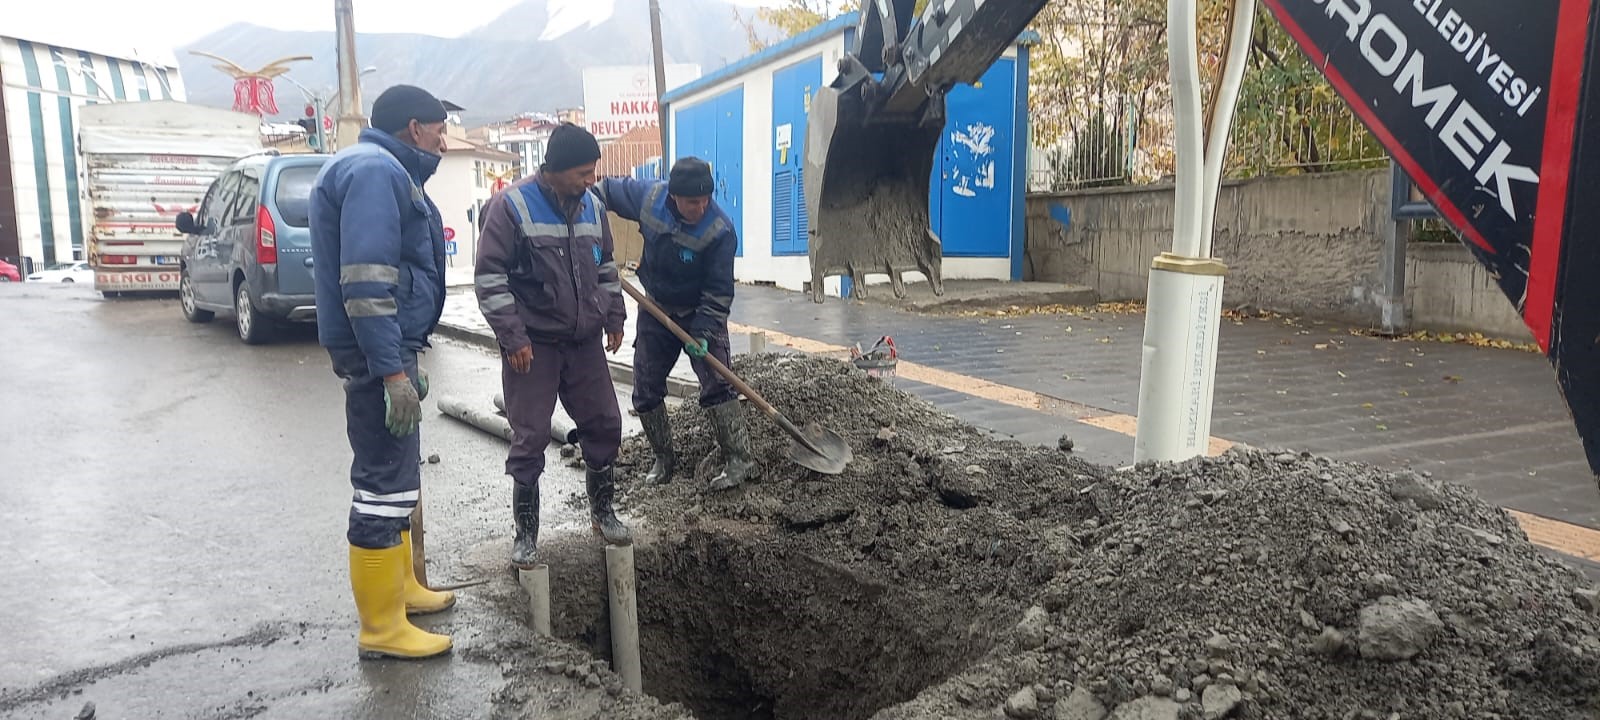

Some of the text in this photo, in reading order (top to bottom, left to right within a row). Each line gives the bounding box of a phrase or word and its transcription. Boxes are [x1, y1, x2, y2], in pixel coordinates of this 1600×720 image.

[1412, 0, 1542, 117] ELEDİYESİ
[610, 100, 659, 115] HAKKA
[1313, 0, 1540, 222] ROMEK
[591, 121, 631, 135] DEVLET
[158, 272, 181, 283] OT
